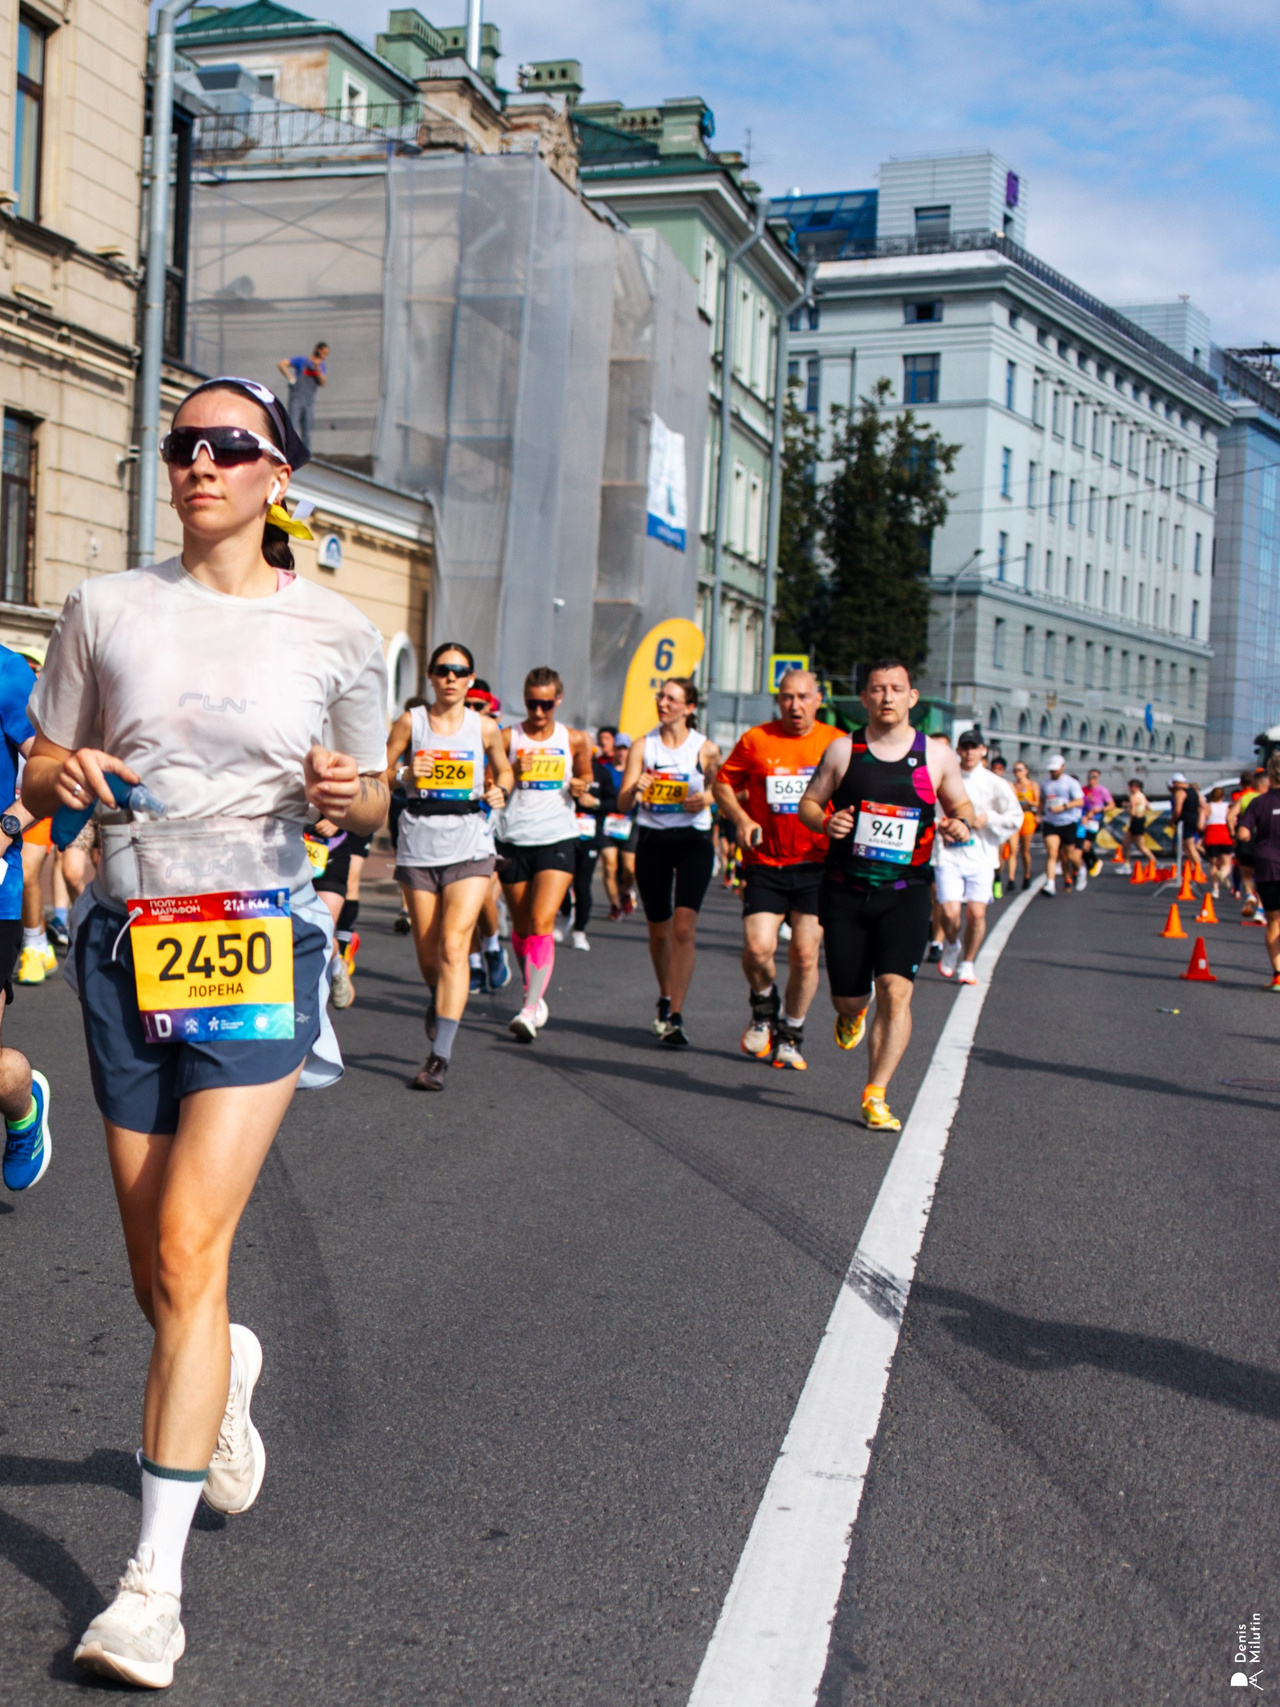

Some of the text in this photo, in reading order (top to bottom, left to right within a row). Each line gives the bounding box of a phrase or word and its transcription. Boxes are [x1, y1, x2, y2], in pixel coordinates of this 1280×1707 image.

[654, 638, 675, 671] 6
[424, 765, 466, 779] 526
[533, 760, 560, 772] 777
[872, 820, 904, 840] 941
[149, 899, 176, 908] ПОЛУ
[151, 905, 201, 916] МАРАФОН
[223, 899, 245, 912] 21,1
[156, 931, 272, 982] 2450
[188, 983, 245, 998] ЛОРЕНА
[154, 1013, 172, 1038] D
